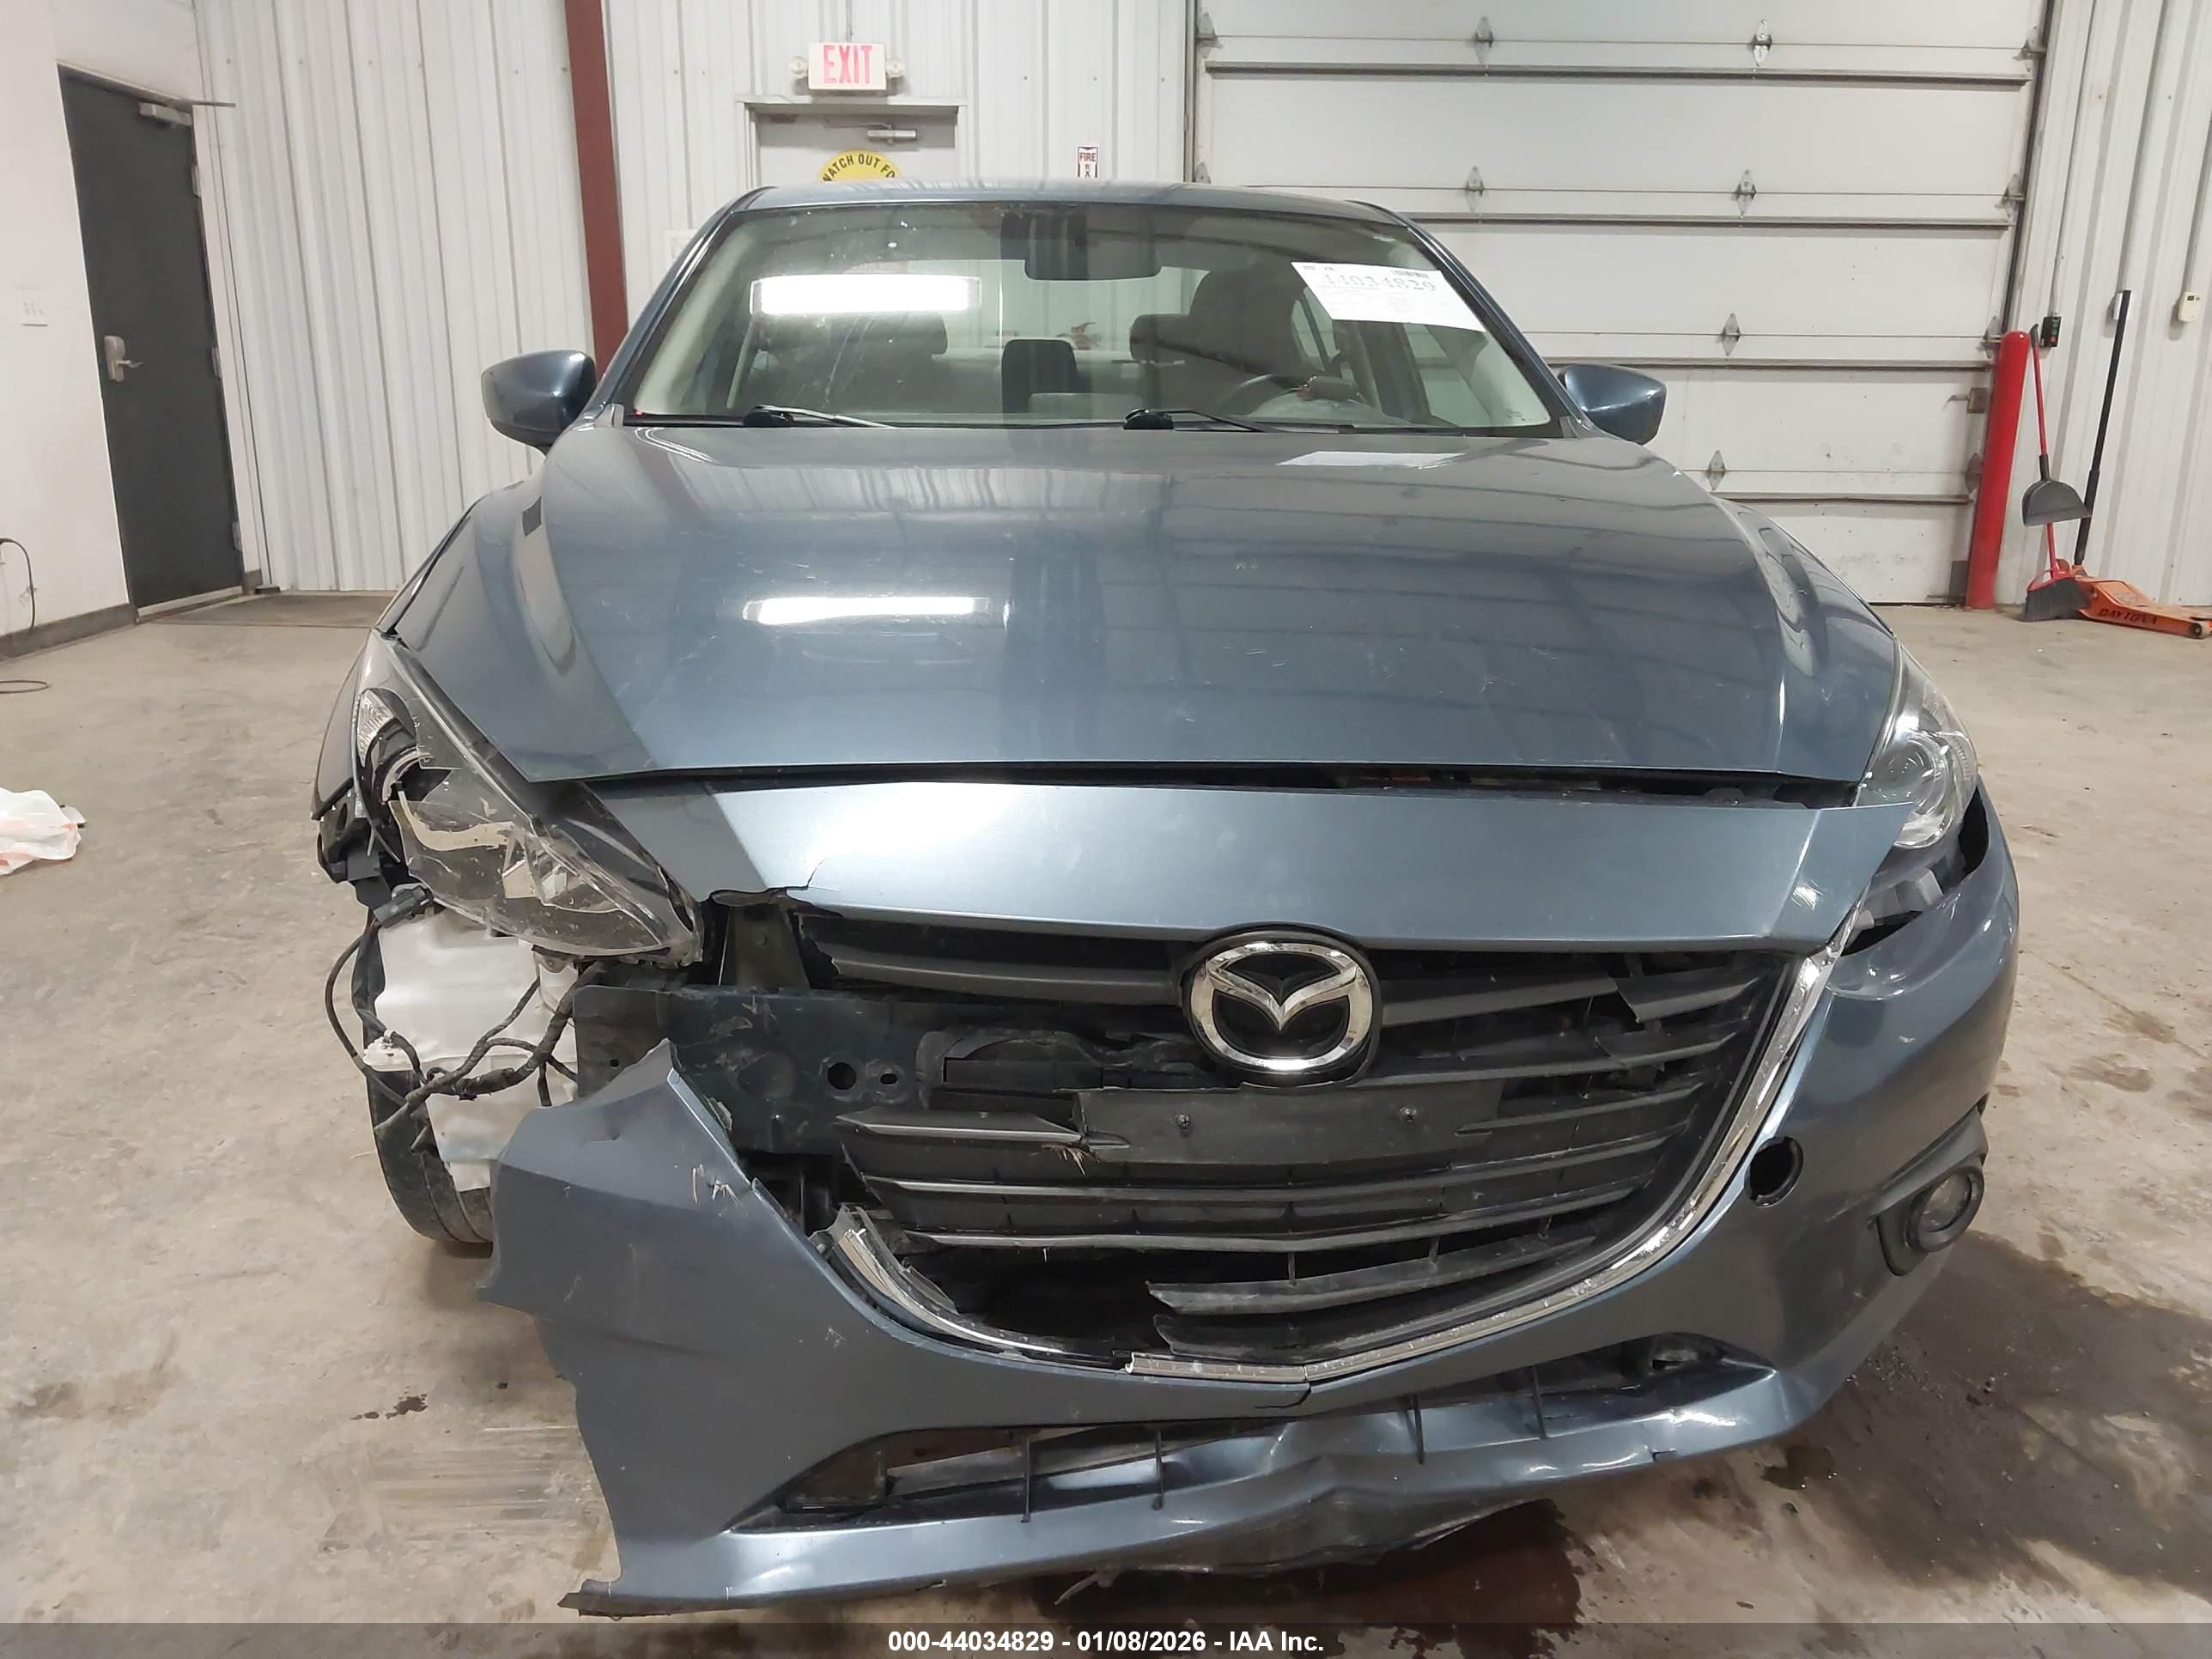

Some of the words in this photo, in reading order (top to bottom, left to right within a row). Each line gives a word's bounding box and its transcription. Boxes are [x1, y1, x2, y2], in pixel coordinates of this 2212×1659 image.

[823, 45, 872, 84] EXIT
[858, 154, 881, 168] OUT
[1079, 152, 1097, 162] FIRE
